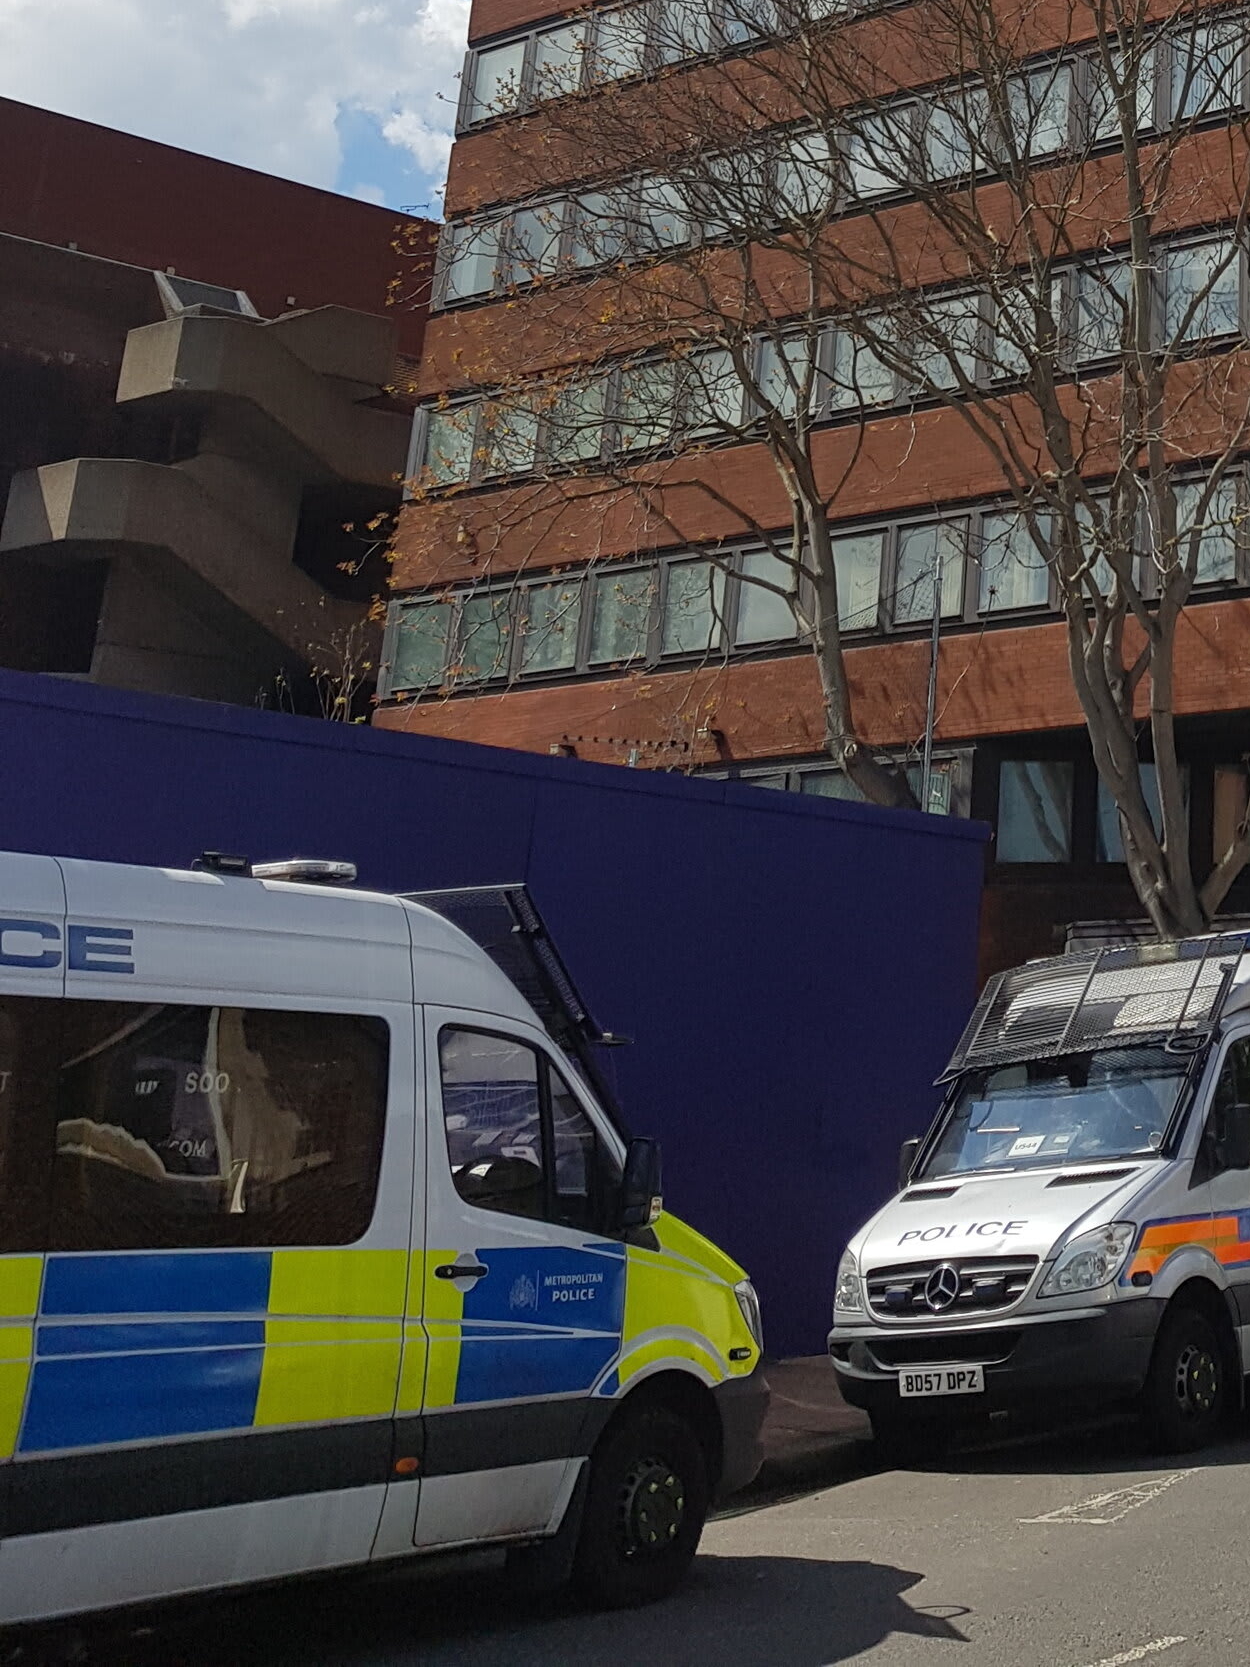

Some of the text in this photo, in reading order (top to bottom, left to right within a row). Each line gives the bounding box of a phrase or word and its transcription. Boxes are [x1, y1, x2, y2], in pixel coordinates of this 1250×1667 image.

[897, 1220, 1030, 1246] POLICE
[544, 1273, 604, 1286] METROPOLITAN
[552, 1288, 596, 1302] POLICE
[905, 1370, 977, 1392] BD57 DPZ
